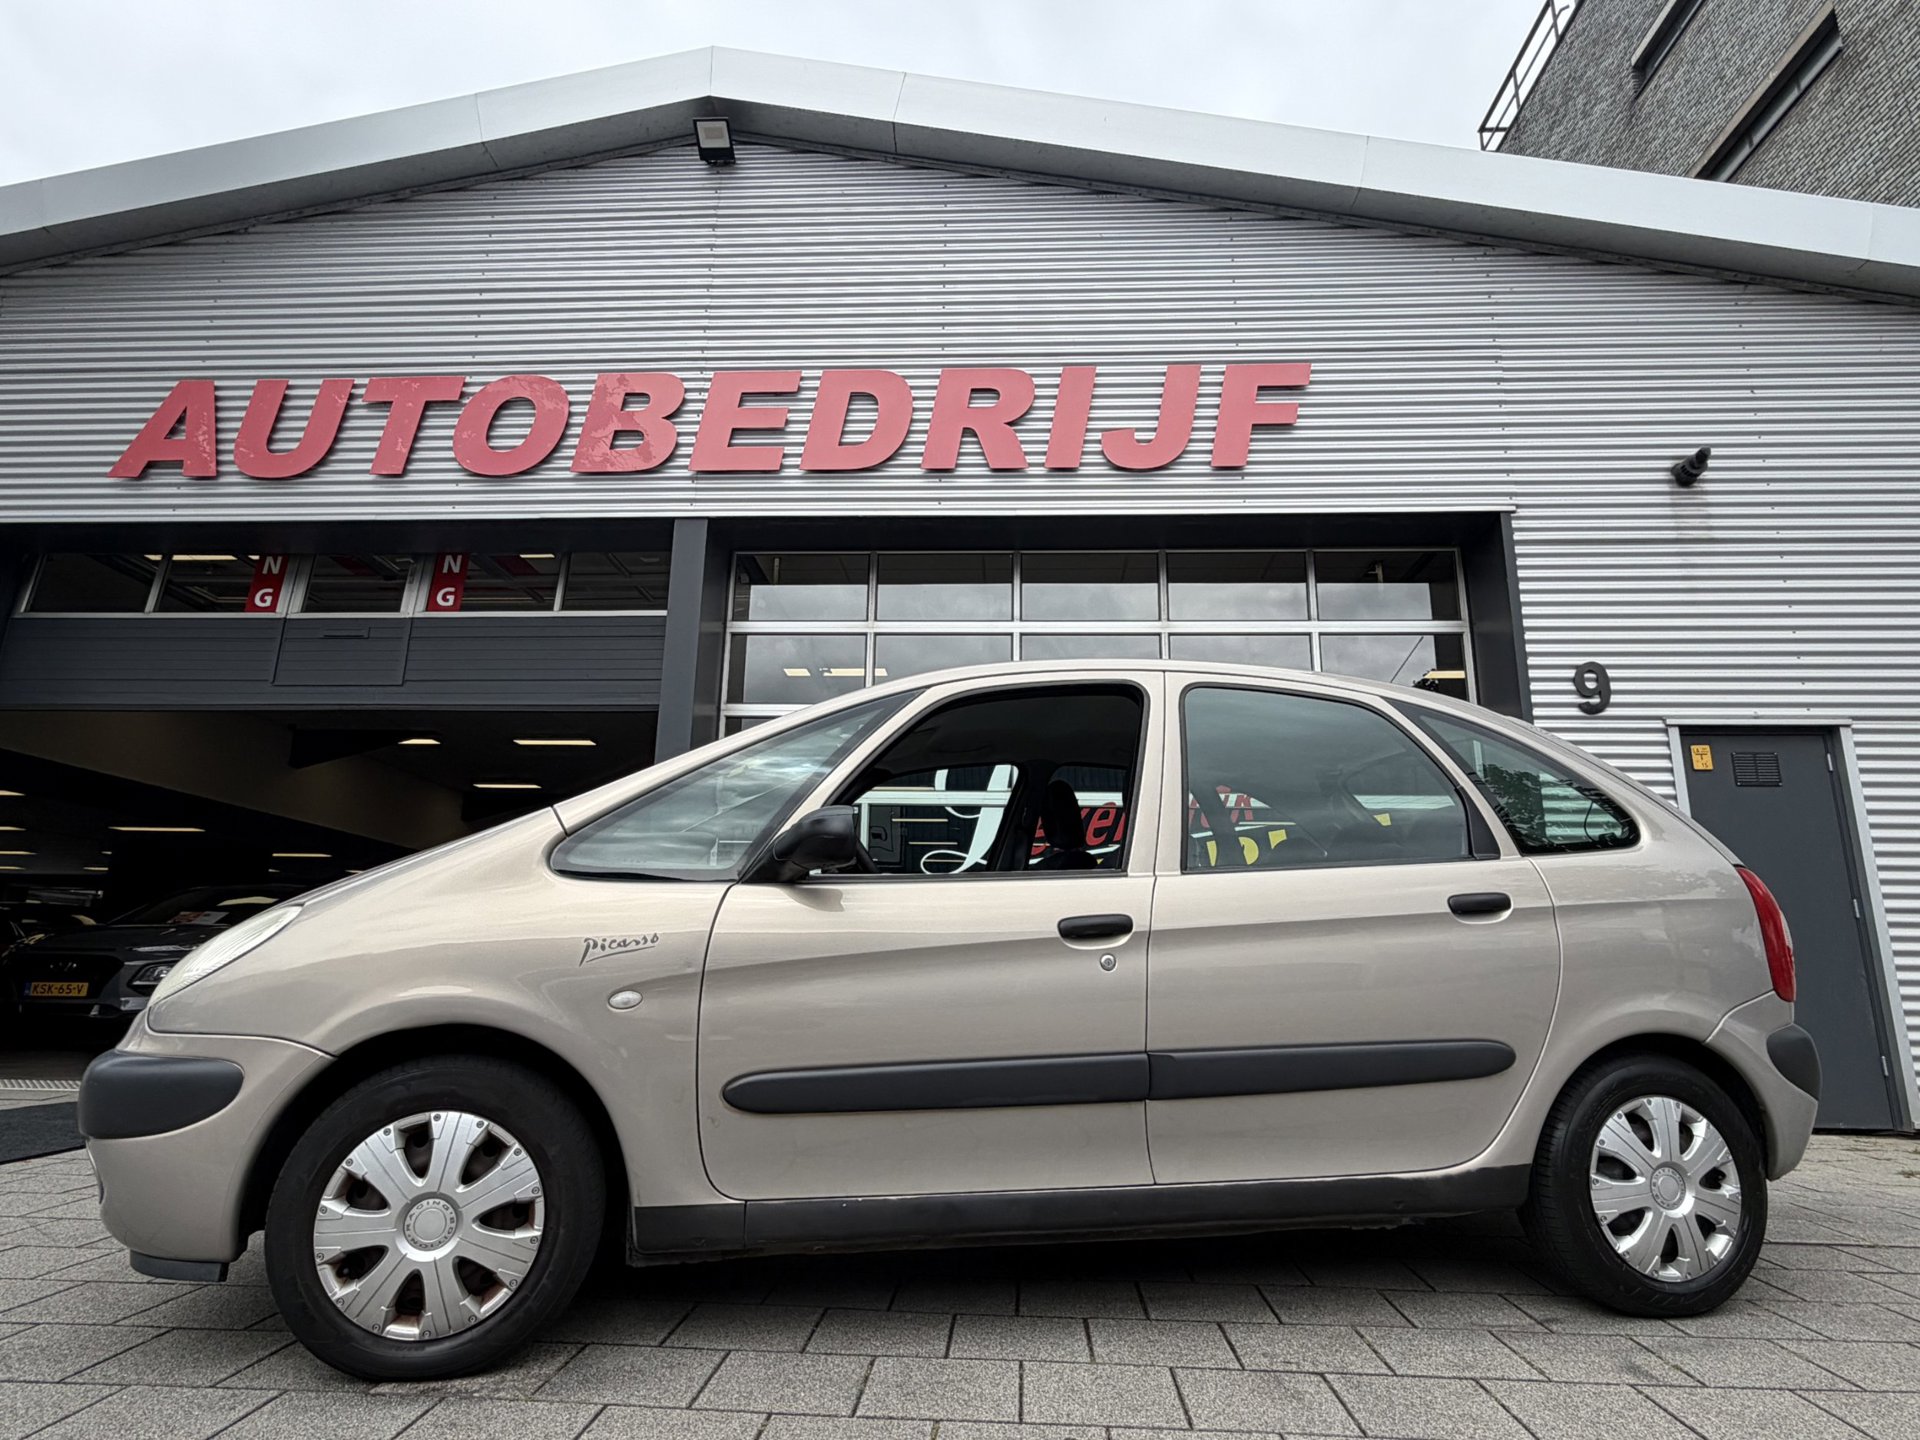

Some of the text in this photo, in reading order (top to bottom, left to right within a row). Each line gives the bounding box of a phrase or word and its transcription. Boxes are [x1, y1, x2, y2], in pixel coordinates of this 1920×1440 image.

[107, 363, 1311, 479] AUTOBEDRIJF
[1573, 661, 1611, 715] 9
[32, 983, 84, 995] KSK-65-V
